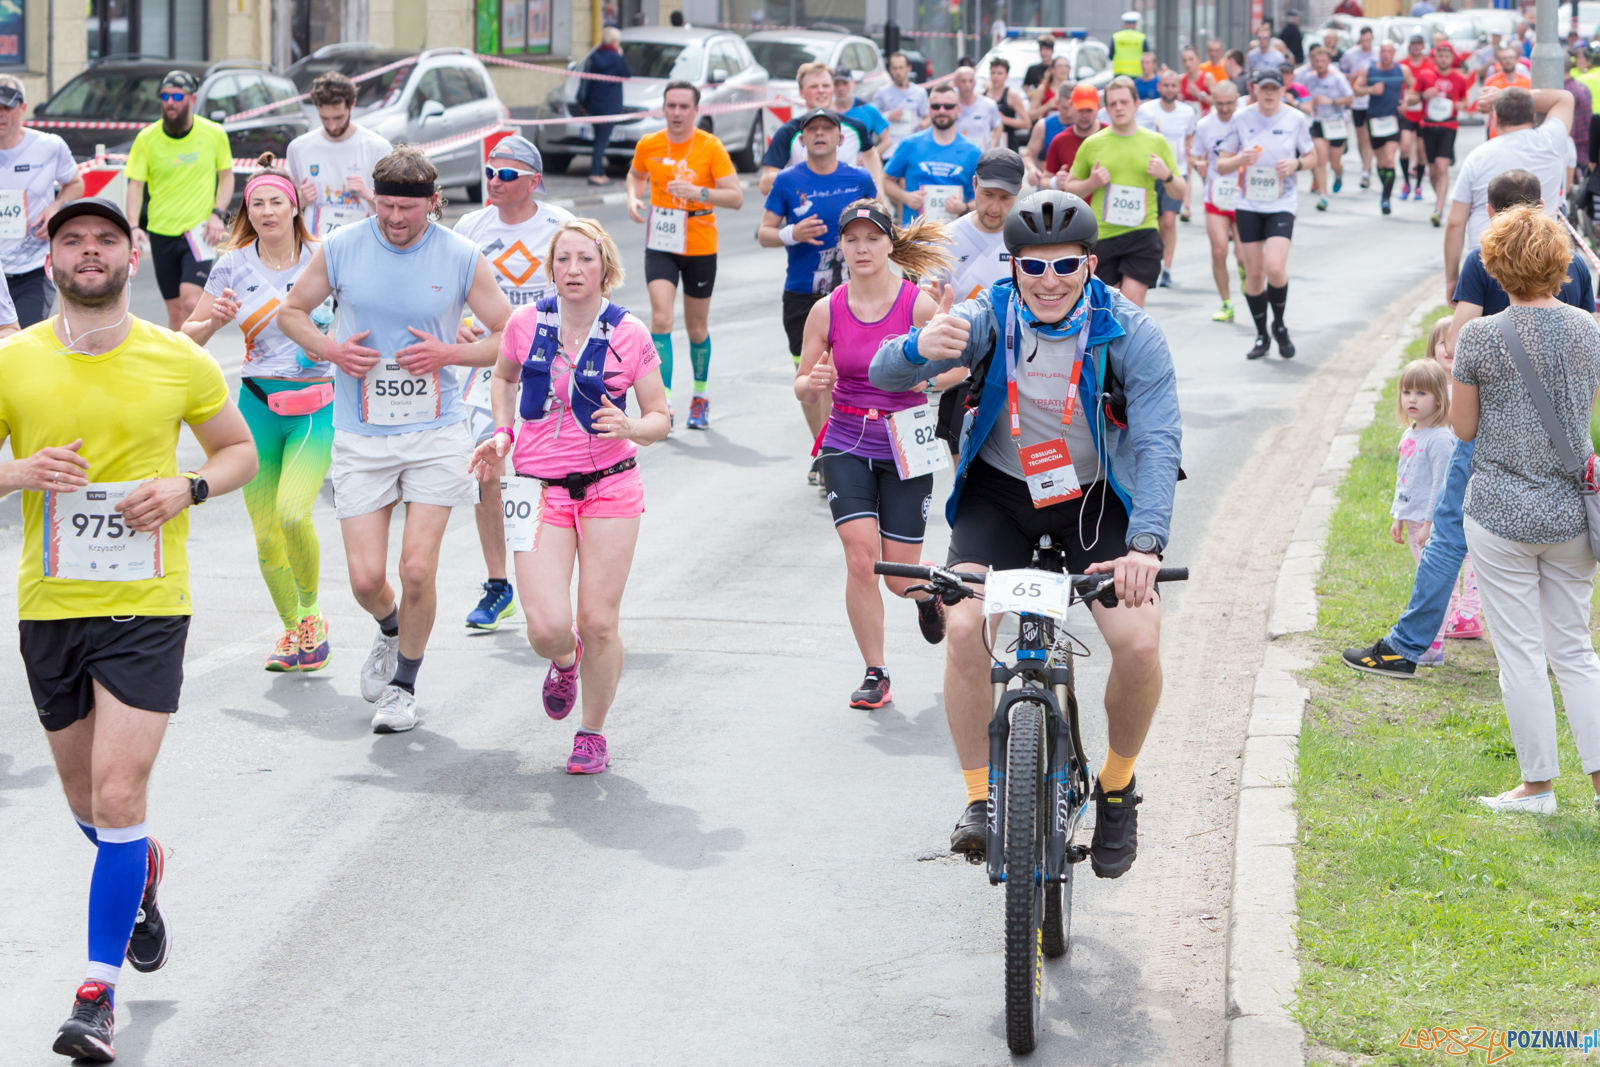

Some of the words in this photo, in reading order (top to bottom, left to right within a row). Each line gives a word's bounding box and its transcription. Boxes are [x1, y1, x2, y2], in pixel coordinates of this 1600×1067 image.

[1250, 177, 1275, 187] 8989
[1112, 198, 1141, 210] 2063
[0, 206, 21, 218] 49
[655, 222, 677, 234] 488
[375, 378, 428, 397] 5502
[1028, 453, 1063, 467] TECHNICZNA
[1030, 448, 1057, 460] OBSŁUGA
[501, 500, 532, 519] 00
[88, 544, 126, 553] Krzysztof
[1012, 582, 1042, 598] 65
[1035, 927, 1043, 998] MAXXIS
